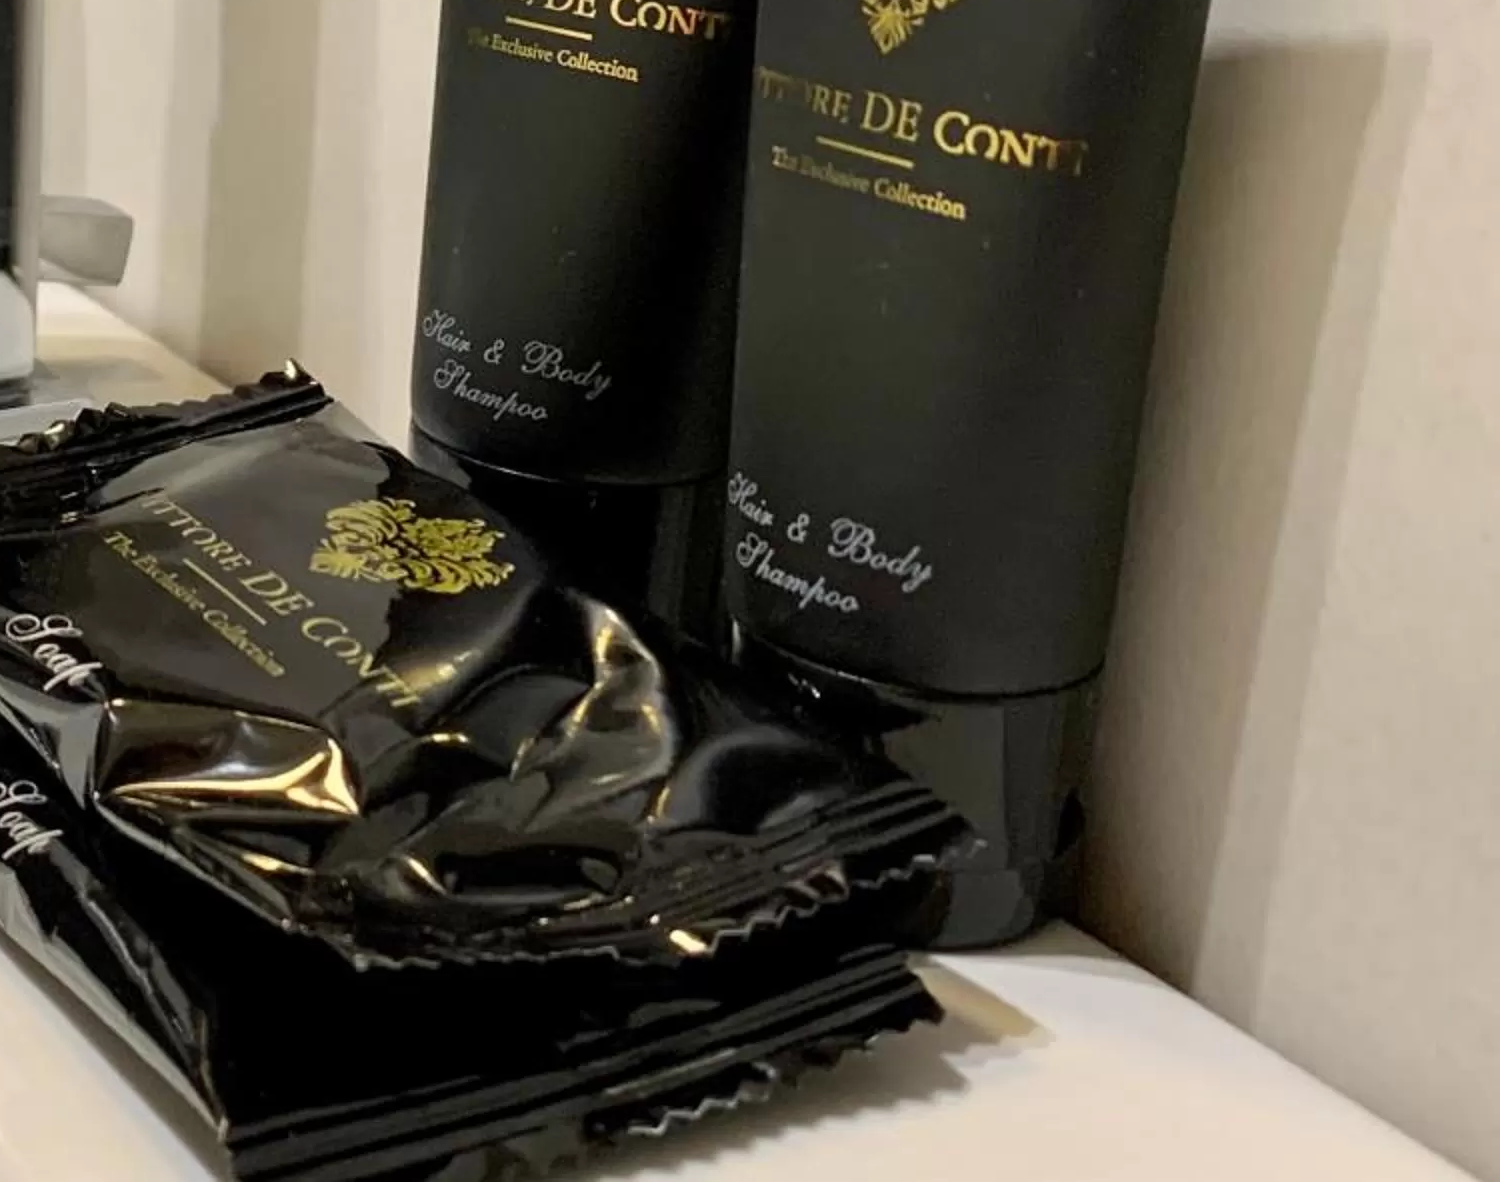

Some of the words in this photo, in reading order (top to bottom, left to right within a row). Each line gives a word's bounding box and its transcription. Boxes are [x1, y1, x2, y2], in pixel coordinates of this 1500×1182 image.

[490, 33, 554, 64] Exclusive
[556, 48, 639, 83] Collection
[859, 89, 924, 143] DE
[872, 177, 967, 222] Collection
[422, 309, 474, 353] Hair
[483, 338, 506, 365] &
[520, 340, 613, 401] Body
[432, 358, 549, 422] Shampoo
[727, 470, 775, 527] Hair
[786, 512, 811, 544] &
[827, 516, 934, 593] Body
[103, 530, 138, 559] The
[131, 553, 206, 611] Exclusive
[203, 608, 287, 678] Collection
[735, 531, 860, 613] Shampoo
[4, 613, 105, 692] Soap
[237, 569, 316, 616] DE
[301, 616, 422, 708] CONTI
